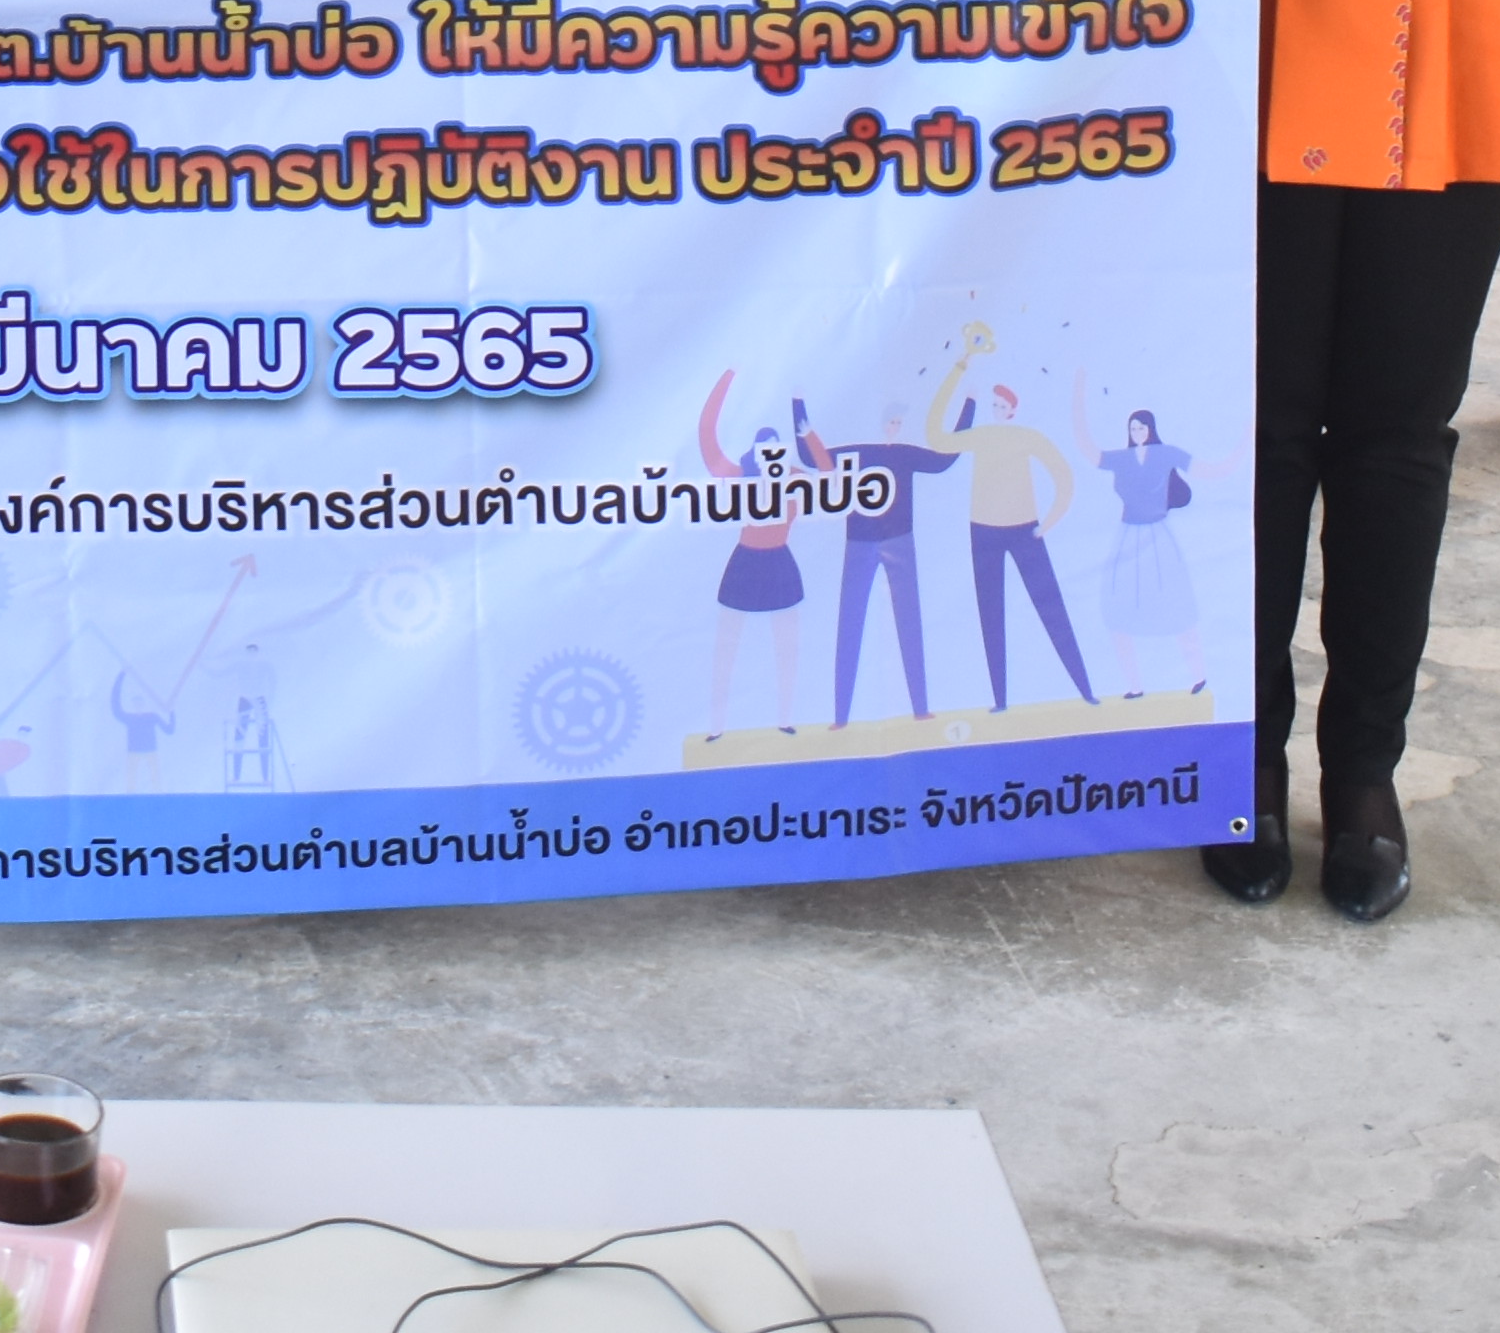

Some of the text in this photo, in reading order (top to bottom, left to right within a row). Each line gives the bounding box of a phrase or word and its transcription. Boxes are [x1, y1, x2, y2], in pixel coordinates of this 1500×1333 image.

[693, 107, 981, 202] ประจำปี
[990, 107, 1174, 191] 2565
[332, 303, 597, 399] 2565
[624, 802, 908, 852] อำเภอปะนาเระ
[920, 761, 1201, 831] จังหวัดปัตตานี
